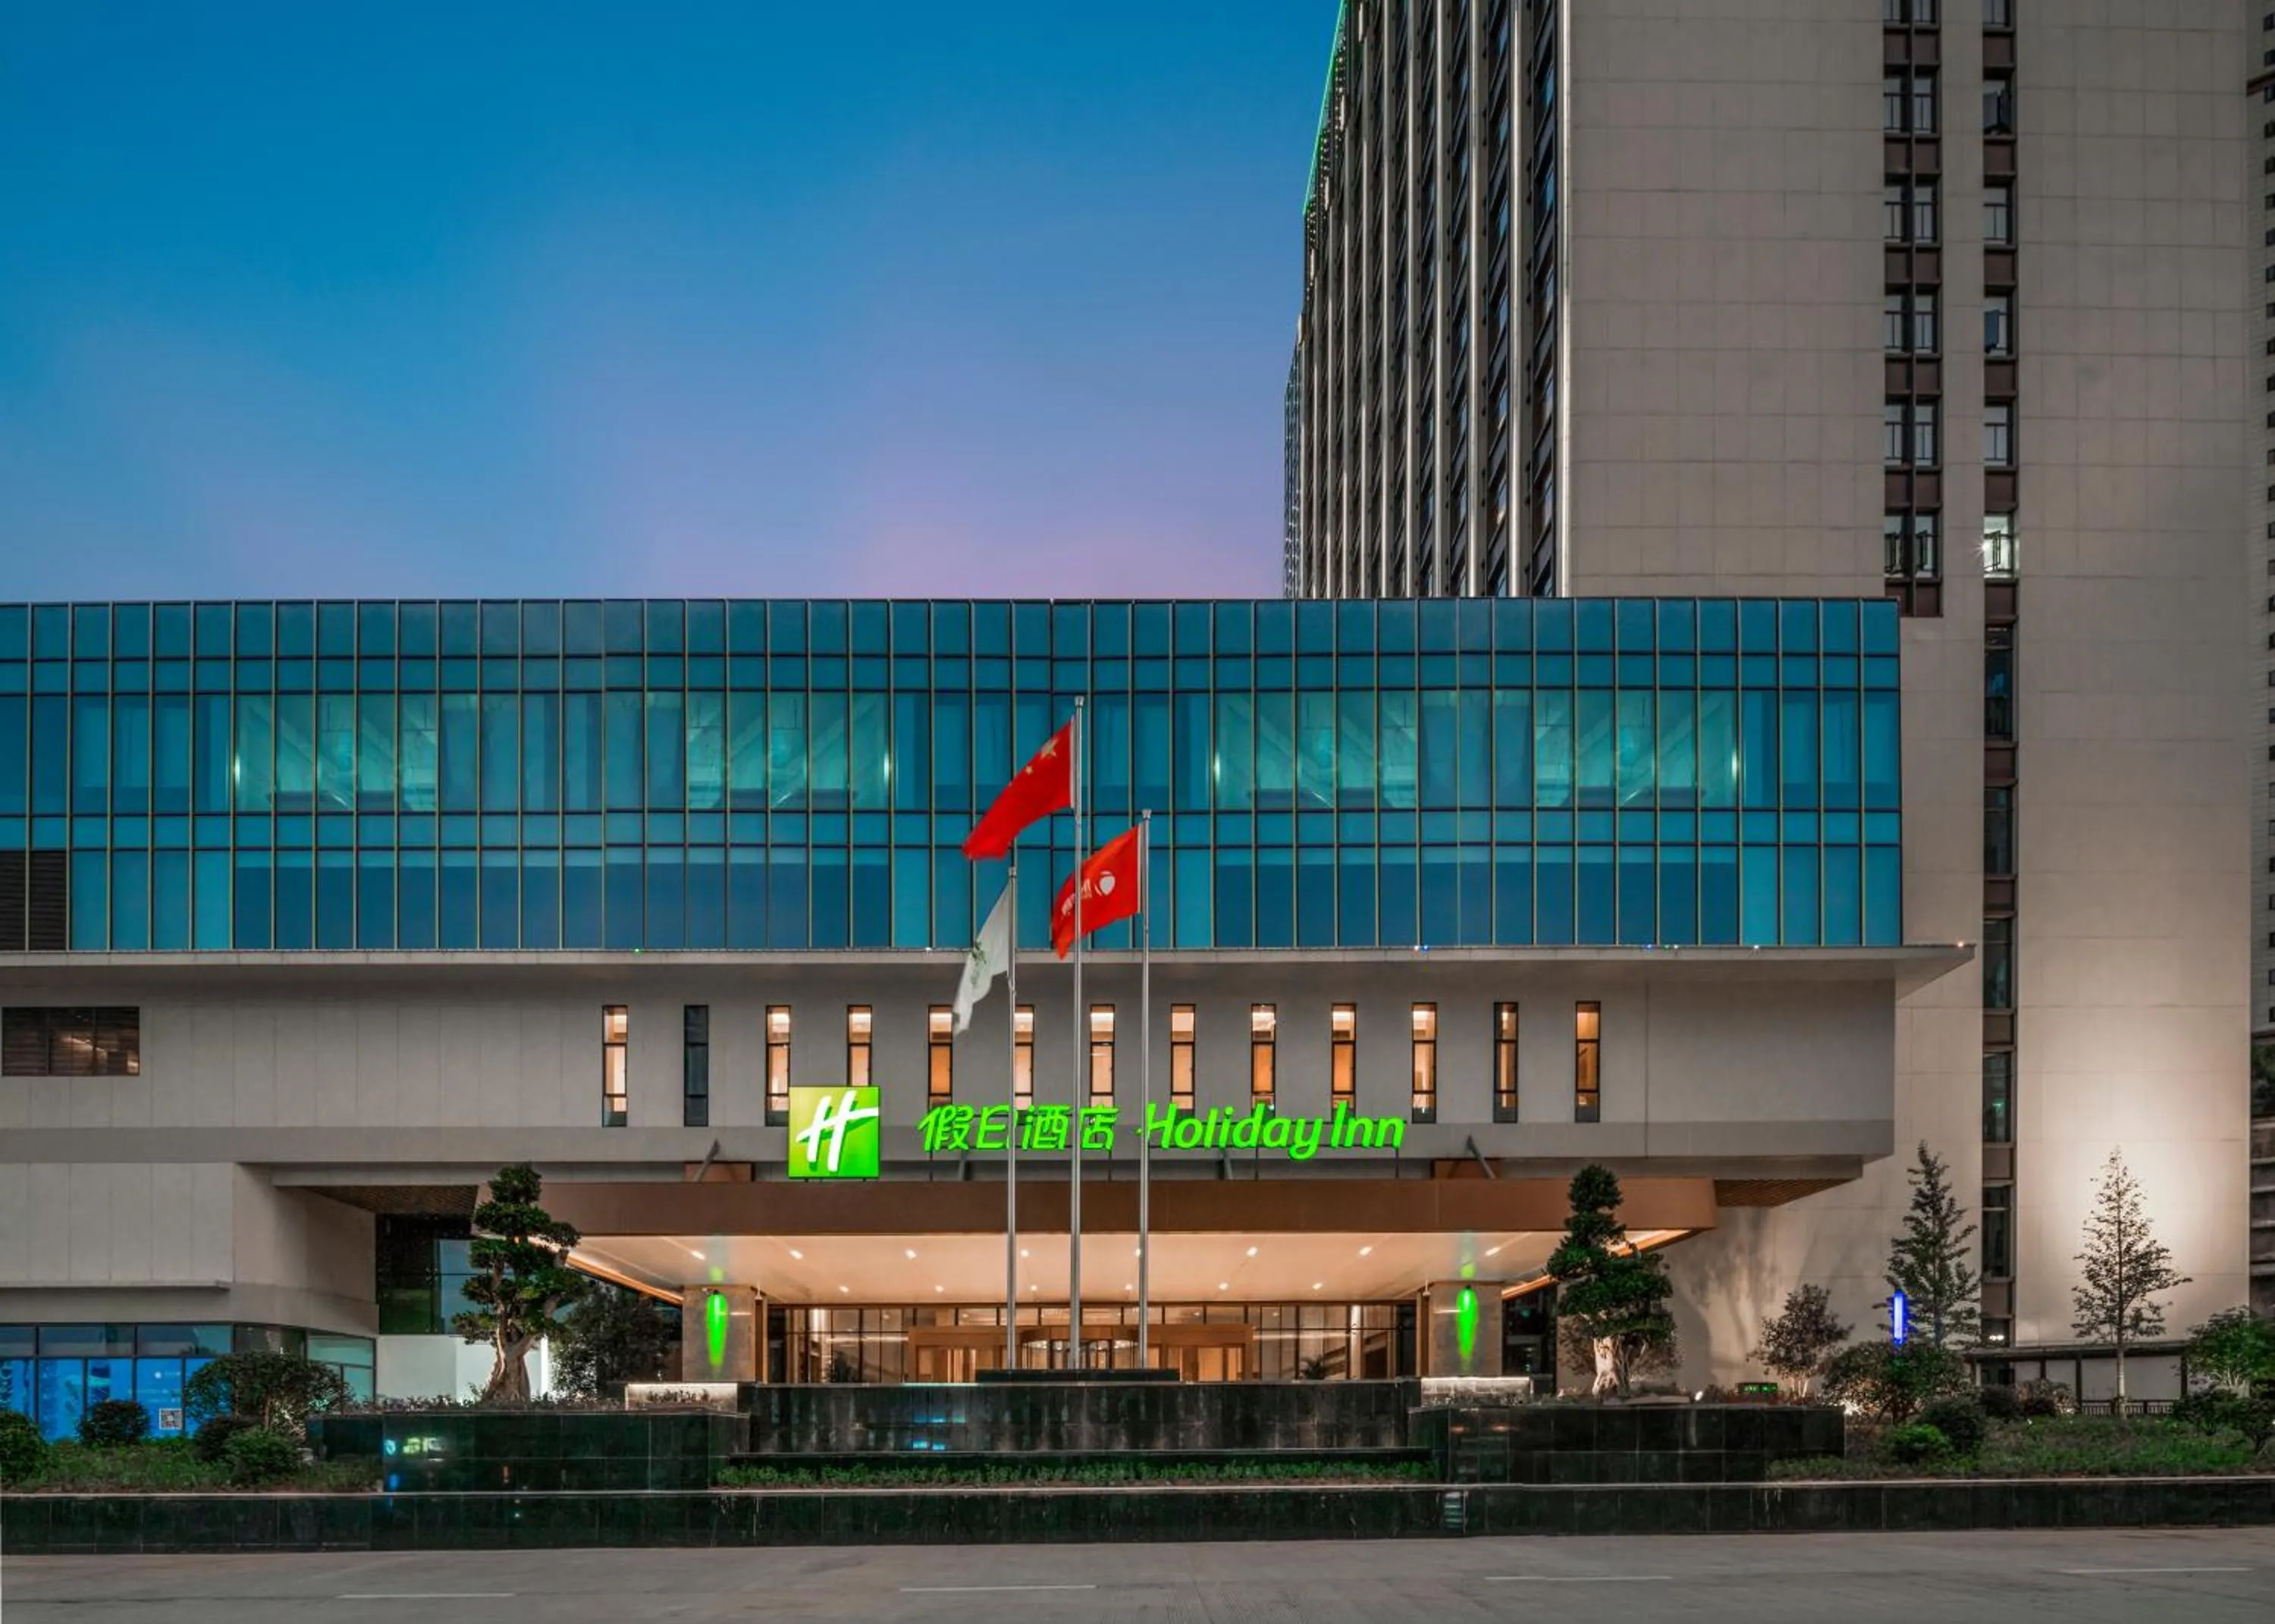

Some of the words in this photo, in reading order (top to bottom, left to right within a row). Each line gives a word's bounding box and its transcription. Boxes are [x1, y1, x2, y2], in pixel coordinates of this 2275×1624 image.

[916, 1103, 1120, 1152] 假日酒店
[1135, 1101, 1325, 1161] Holiday
[1329, 1101, 1407, 1151] Inn
